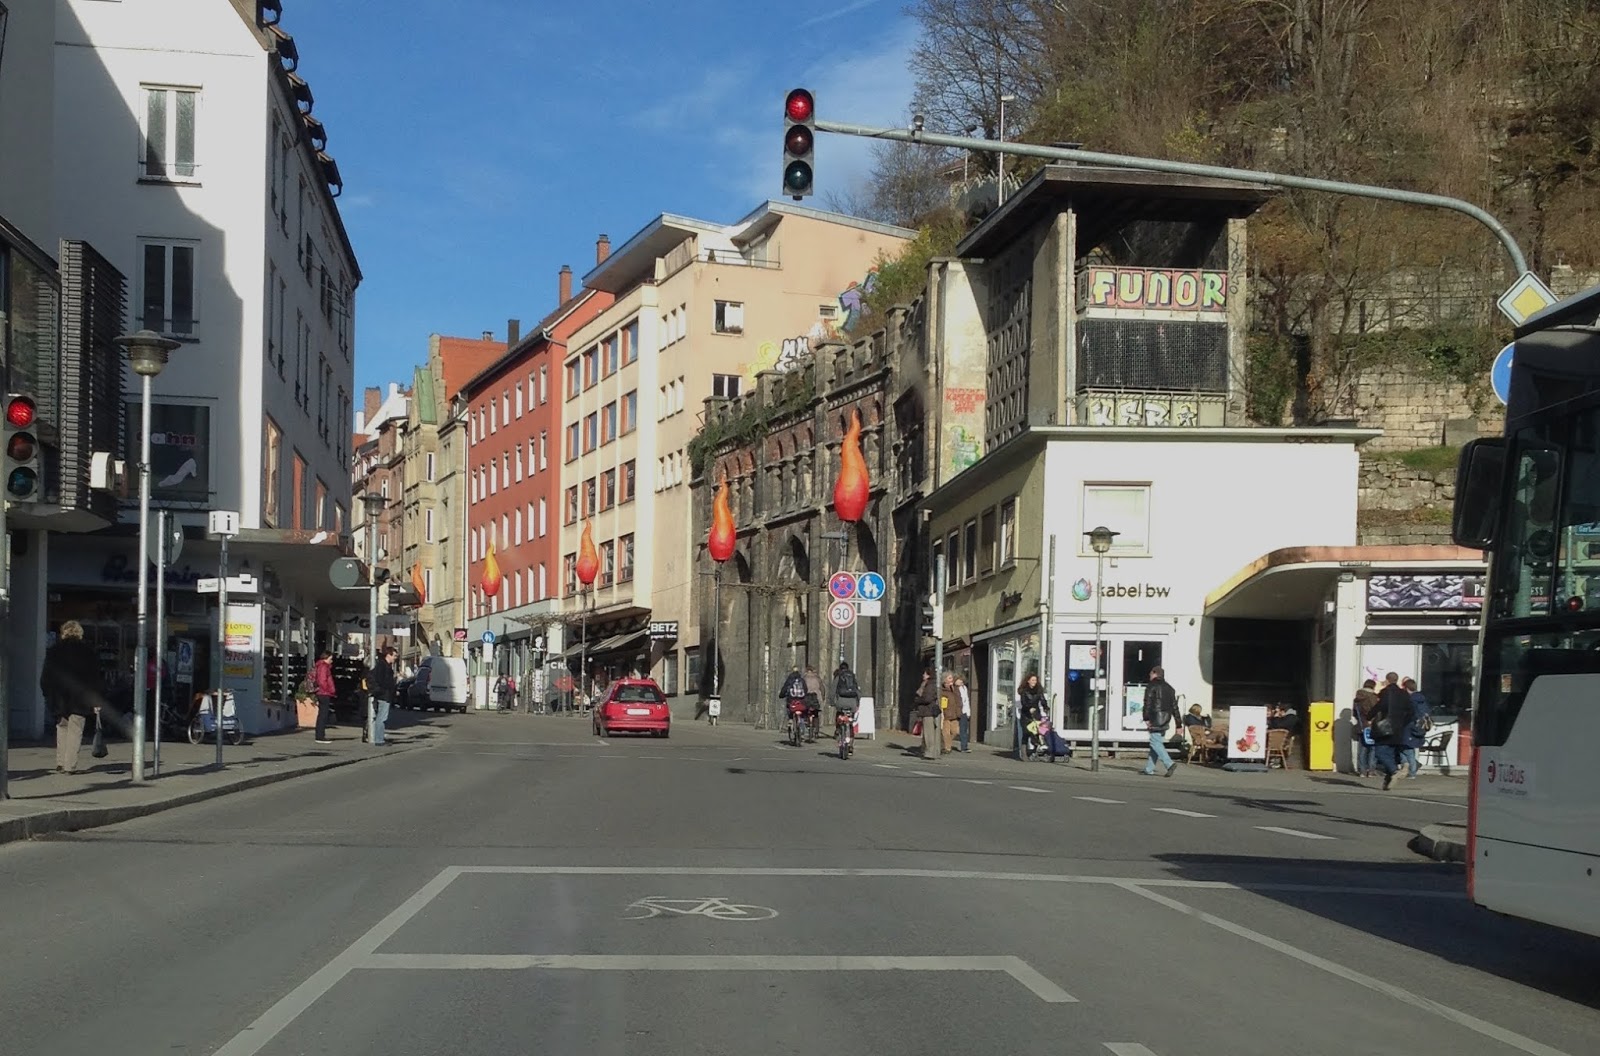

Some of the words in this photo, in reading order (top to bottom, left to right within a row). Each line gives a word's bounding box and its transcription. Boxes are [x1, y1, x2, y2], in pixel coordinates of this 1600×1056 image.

[1097, 582, 1142, 598] kabel
[1145, 583, 1171, 598] bw
[834, 607, 850, 620] 30
[650, 622, 678, 633] BETZ
